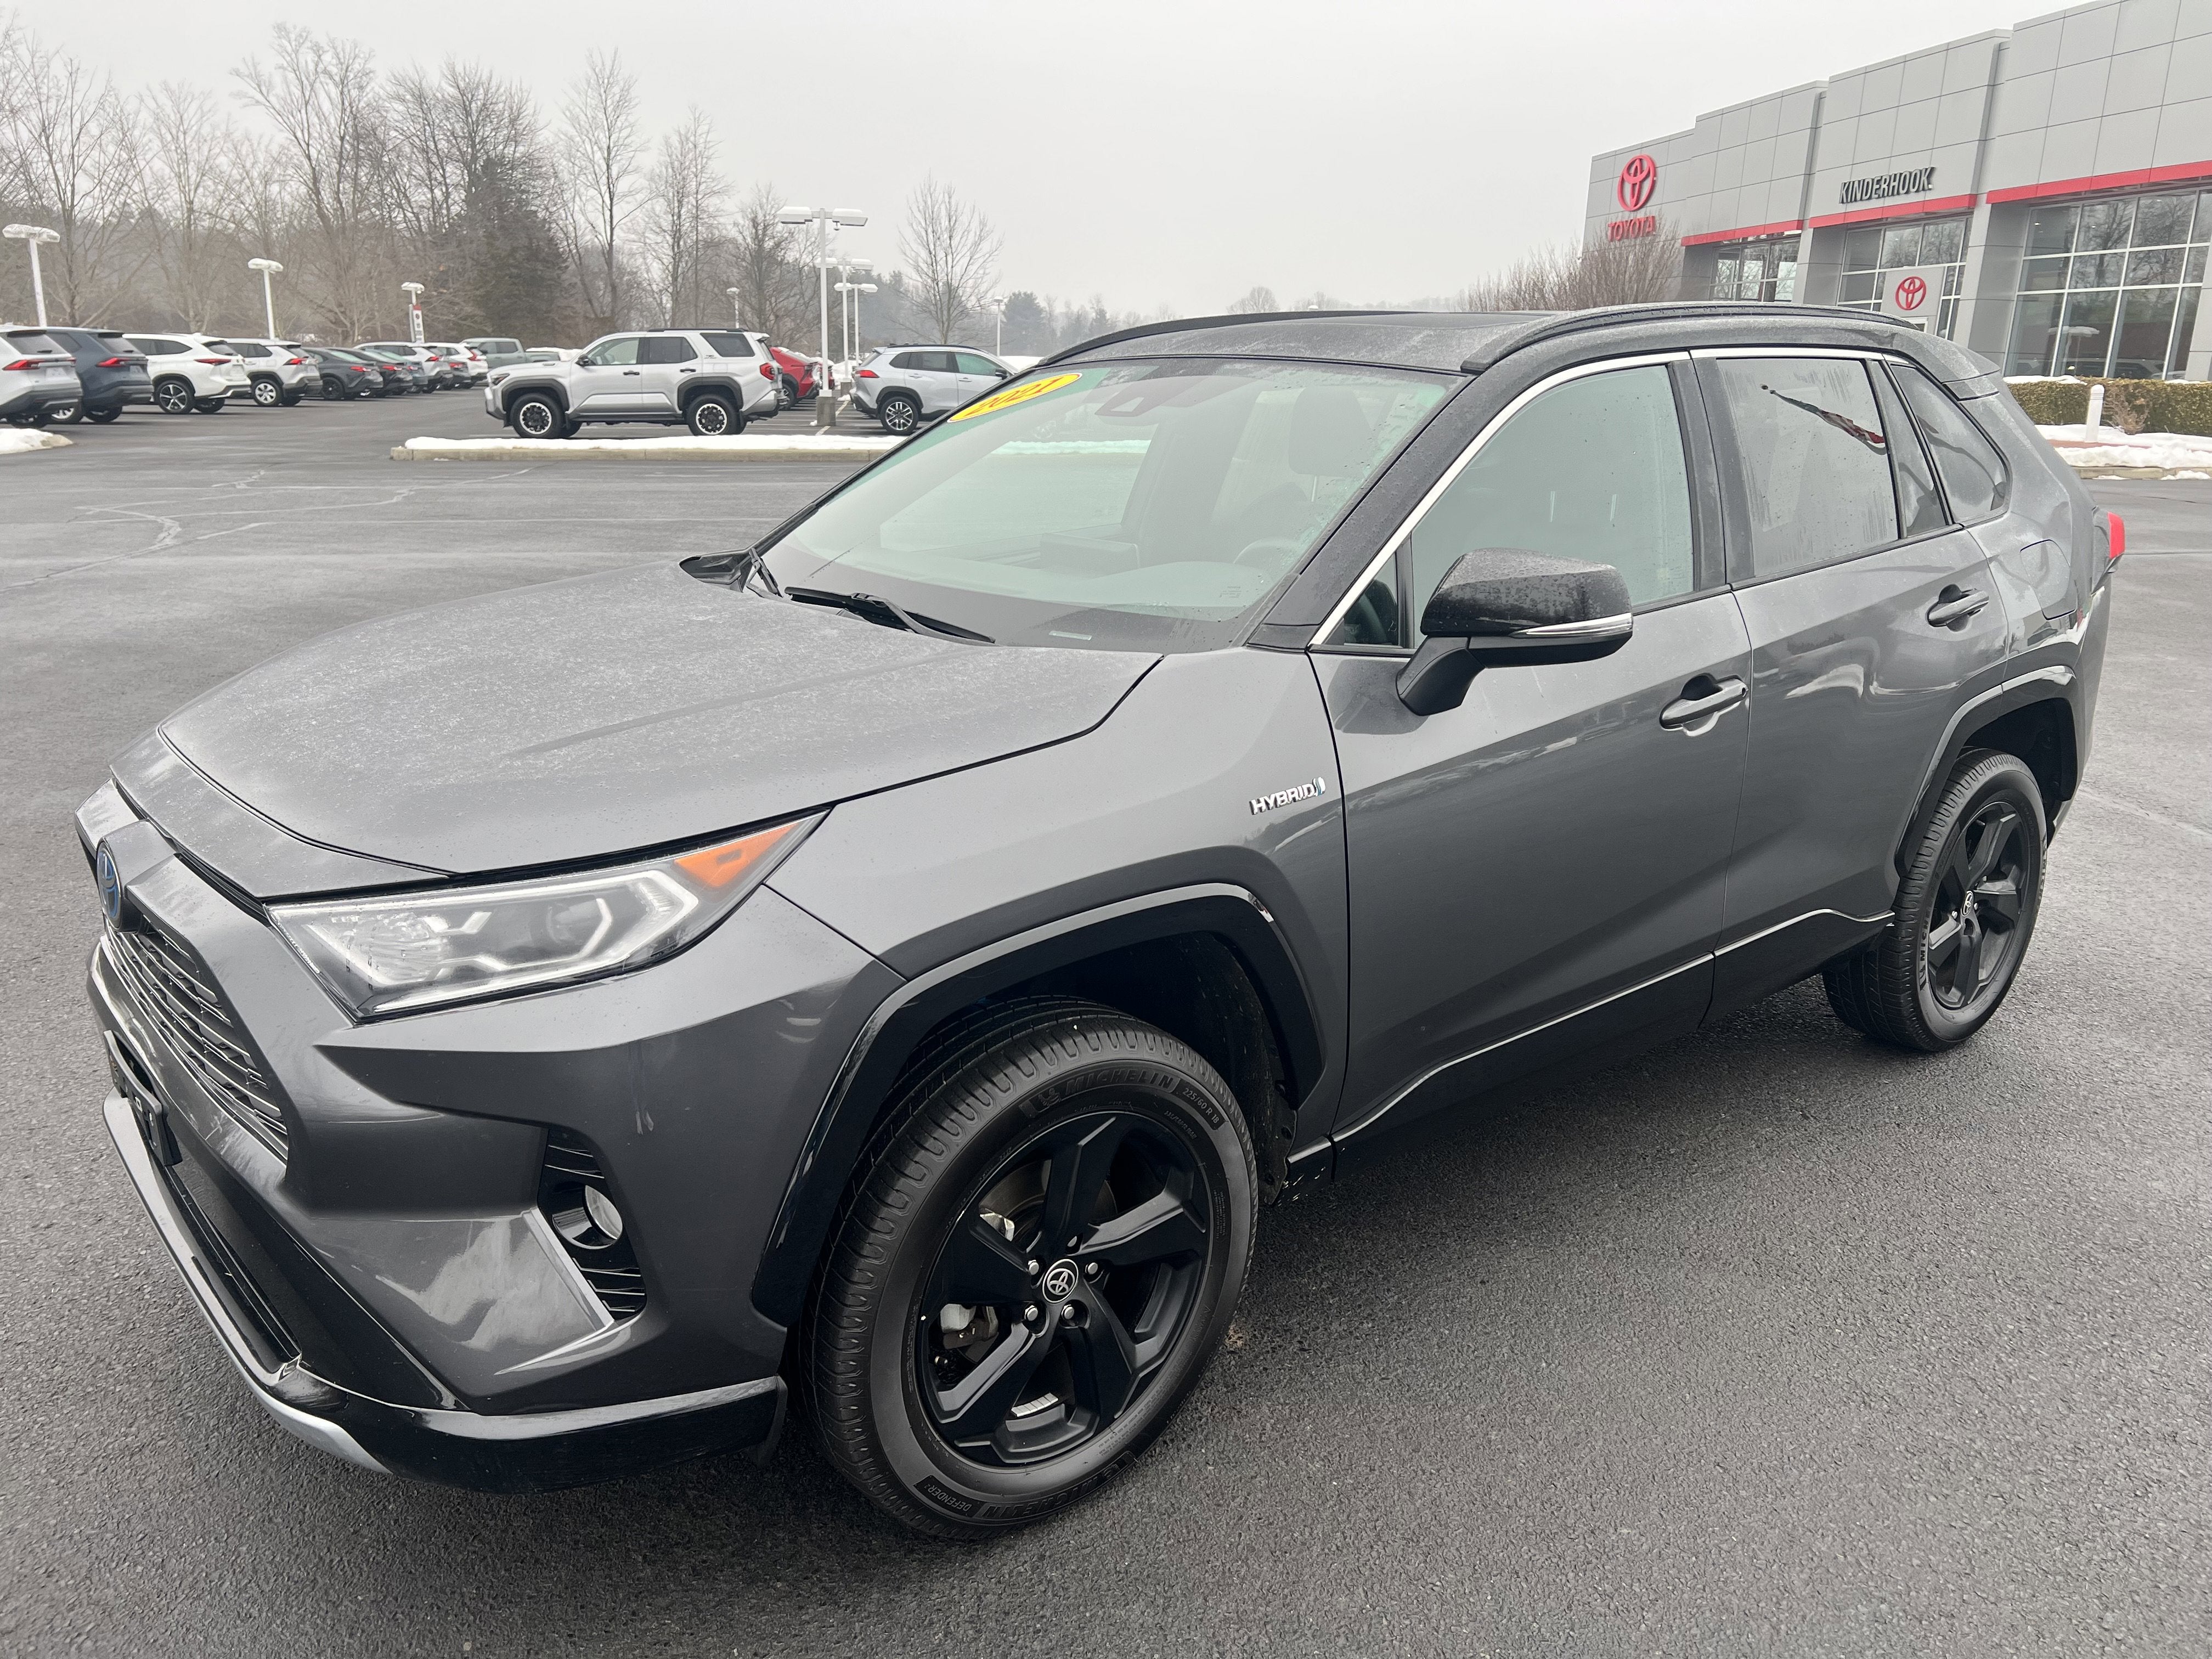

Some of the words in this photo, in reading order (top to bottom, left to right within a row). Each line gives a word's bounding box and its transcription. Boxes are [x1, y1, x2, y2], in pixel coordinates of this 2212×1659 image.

[1839, 167, 1936, 204] KINDERHOOK
[1607, 216, 1655, 241] TOYOTA
[963, 376, 1064, 417] 2021
[1249, 783, 1317, 815] HYBRID
[1065, 1068, 1174, 1094] MICHELIN
[1182, 1087, 1207, 1109] 225/60
[1205, 1107, 1213, 1116] R
[1211, 1114, 1220, 1124] 18
